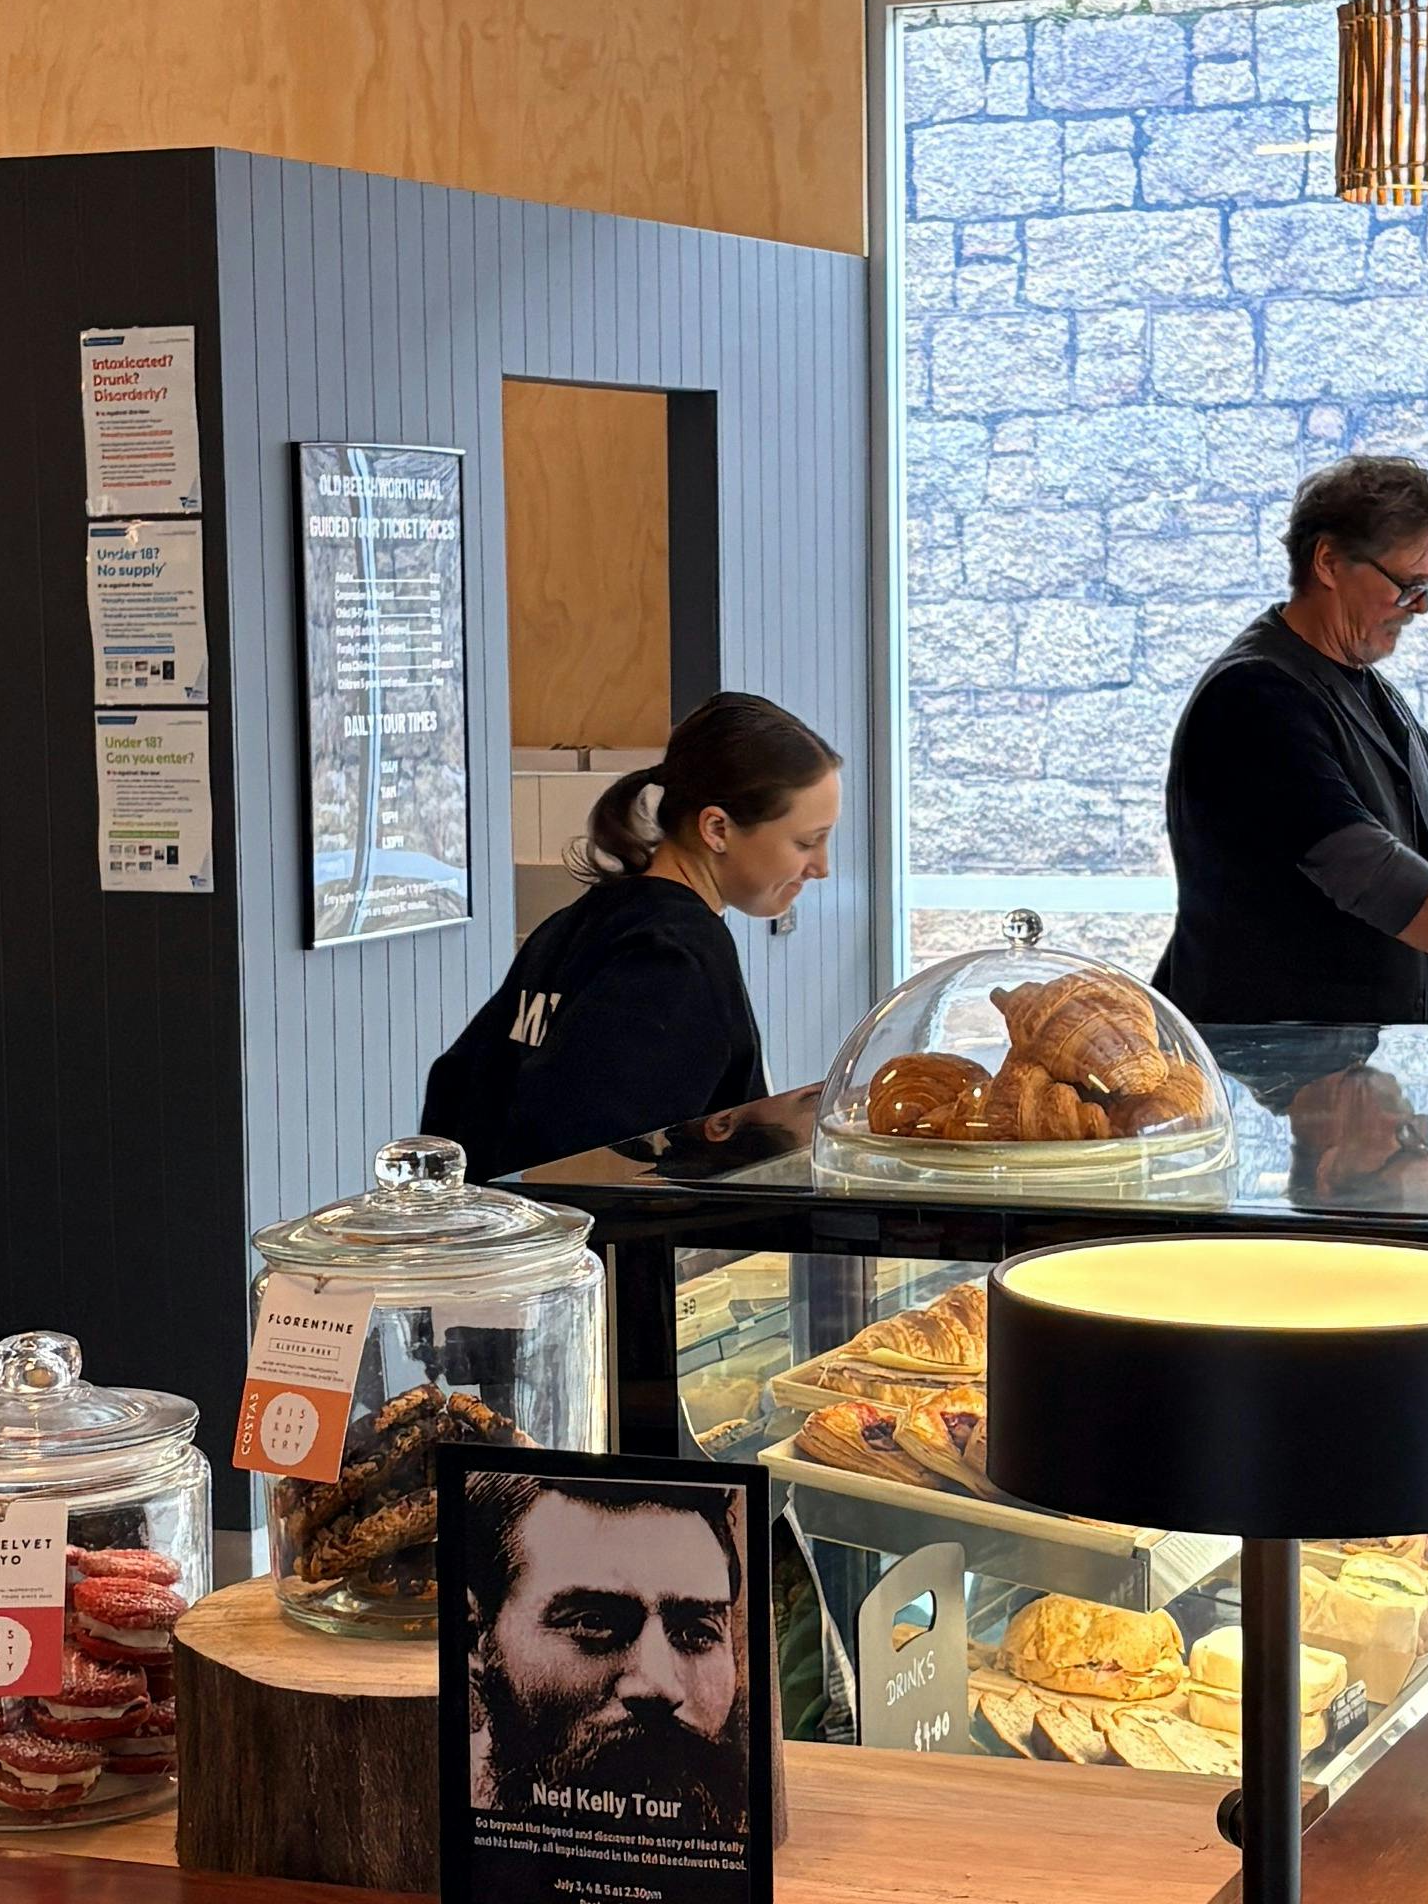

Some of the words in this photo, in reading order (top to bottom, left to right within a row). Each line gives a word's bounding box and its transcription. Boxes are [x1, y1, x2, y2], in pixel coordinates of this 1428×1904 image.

[92, 354, 173, 371] Intoxicated?
[93, 372, 140, 386] Drunk?
[94, 388, 168, 403] Disorderly?
[320, 474, 341, 497] OLD
[417, 478, 444, 501] GAOL
[310, 516, 350, 538] GUIDED
[351, 517, 380, 539] TOUR
[382, 517, 419, 539] TICKET
[420, 519, 456, 540] PRICES
[97, 548, 137, 561] Under
[140, 547, 160, 560] 18?
[97, 564, 116, 577] No
[119, 563, 166, 578] supply
[344, 714, 374, 738] DAILY
[376, 713, 405, 735] TOUR
[407, 710, 437, 733] TIMES
[105, 736, 142, 749] Under
[144, 736, 163, 749] 18?
[106, 752, 130, 765] Can
[131, 753, 154, 766] you
[156, 752, 195, 765] enter?
[268, 1313, 355, 1335] FLORENTINE
[241, 1392, 260, 1456] COSTAS
[885, 1650, 936, 1706] DRINKS
[532, 1782, 572, 1808] Ned
[576, 1788, 627, 1819] Kelly
[632, 1793, 682, 1819] Tour
[475, 1816, 488, 1828] Go
[489, 1819, 524, 1833] beyond
[525, 1822, 541, 1834] the
[575, 1829, 593, 1841] and
[594, 1831, 636, 1845] discover
[637, 1835, 655, 1847] the
[656, 1837, 683, 1851] story
[684, 1838, 695, 1850] of
[696, 1839, 717, 1851] Ned
[719, 1841, 745, 1856] Kelly
[474, 1835, 492, 1847] and
[493, 1836, 508, 1848] his
[509, 1838, 541, 1854] family,
[611, 1849, 622, 1861] in
[623, 1851, 640, 1863] the
[641, 1852, 658, 1865] Old
[659, 1854, 720, 1869] Beechworth
[554, 1878, 574, 1893] July
[576, 1881, 585, 1894] 3,
[586, 1881, 593, 1894] 4
[594, 1883, 603, 1895] &
[604, 1884, 611, 1895] 5
[612, 1885, 623, 1897] at
[624, 1886, 662, 1901] 2.30pm
